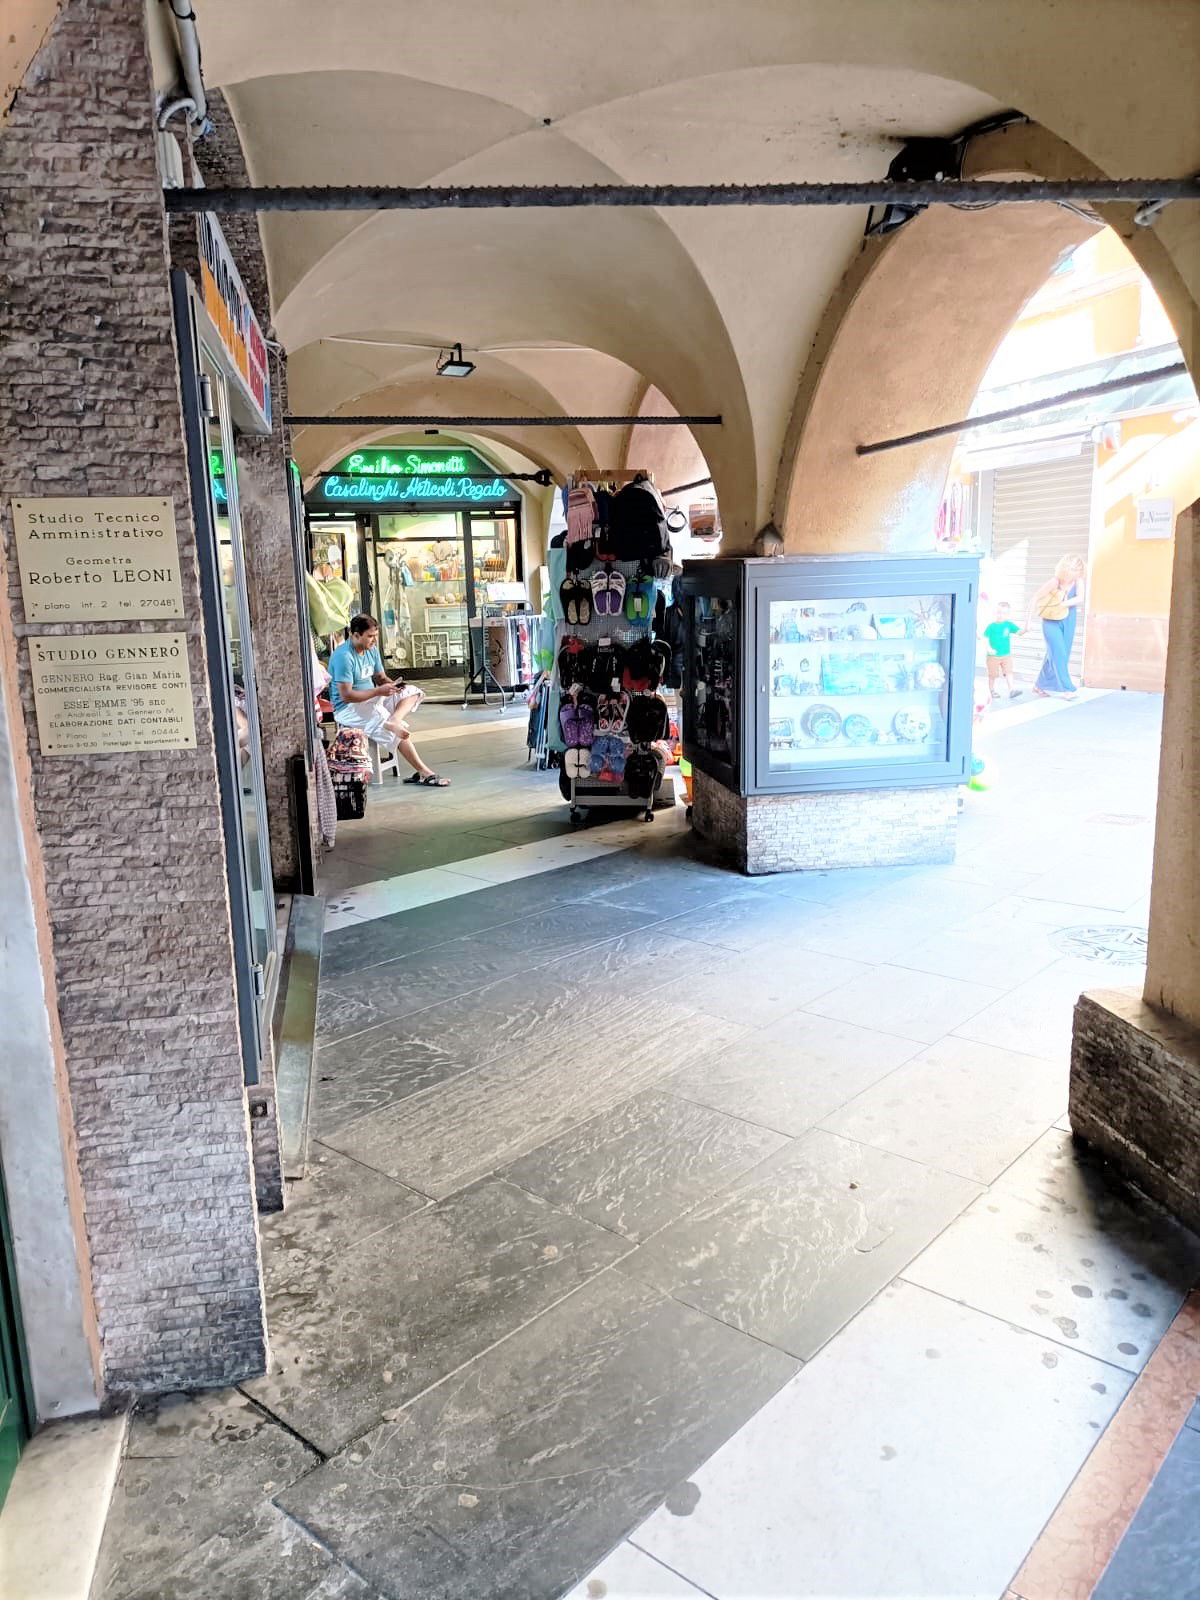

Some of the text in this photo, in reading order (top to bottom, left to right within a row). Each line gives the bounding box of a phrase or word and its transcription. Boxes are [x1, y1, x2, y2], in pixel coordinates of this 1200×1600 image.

[348, 454, 465, 474] Emilio Simonetti
[325, 476, 507, 501] Casalinghi Articoli Regalo
[28, 512, 160, 524] Studio Tecnico
[28, 528, 164, 540] Amministrativo
[65, 556, 132, 566] Geometra
[29, 569, 173, 585] Roberto LEONI
[44, 602, 70, 611] piano
[101, 600, 108, 608] 2
[140, 599, 176, 607] 270481
[38, 646, 180, 662] STUDIO GENNERO
[41, 670, 181, 684] GENNERO Rag. Gian Maria
[37, 682, 187, 695] COMMERCIALISTA REVISORE CONTI
[63, 700, 90, 710] ESSE
[94, 698, 127, 708] EMME
[148, 698, 166, 706] snc
[49, 716, 183, 729] ELABORAZIONE DATI CONTABILI
